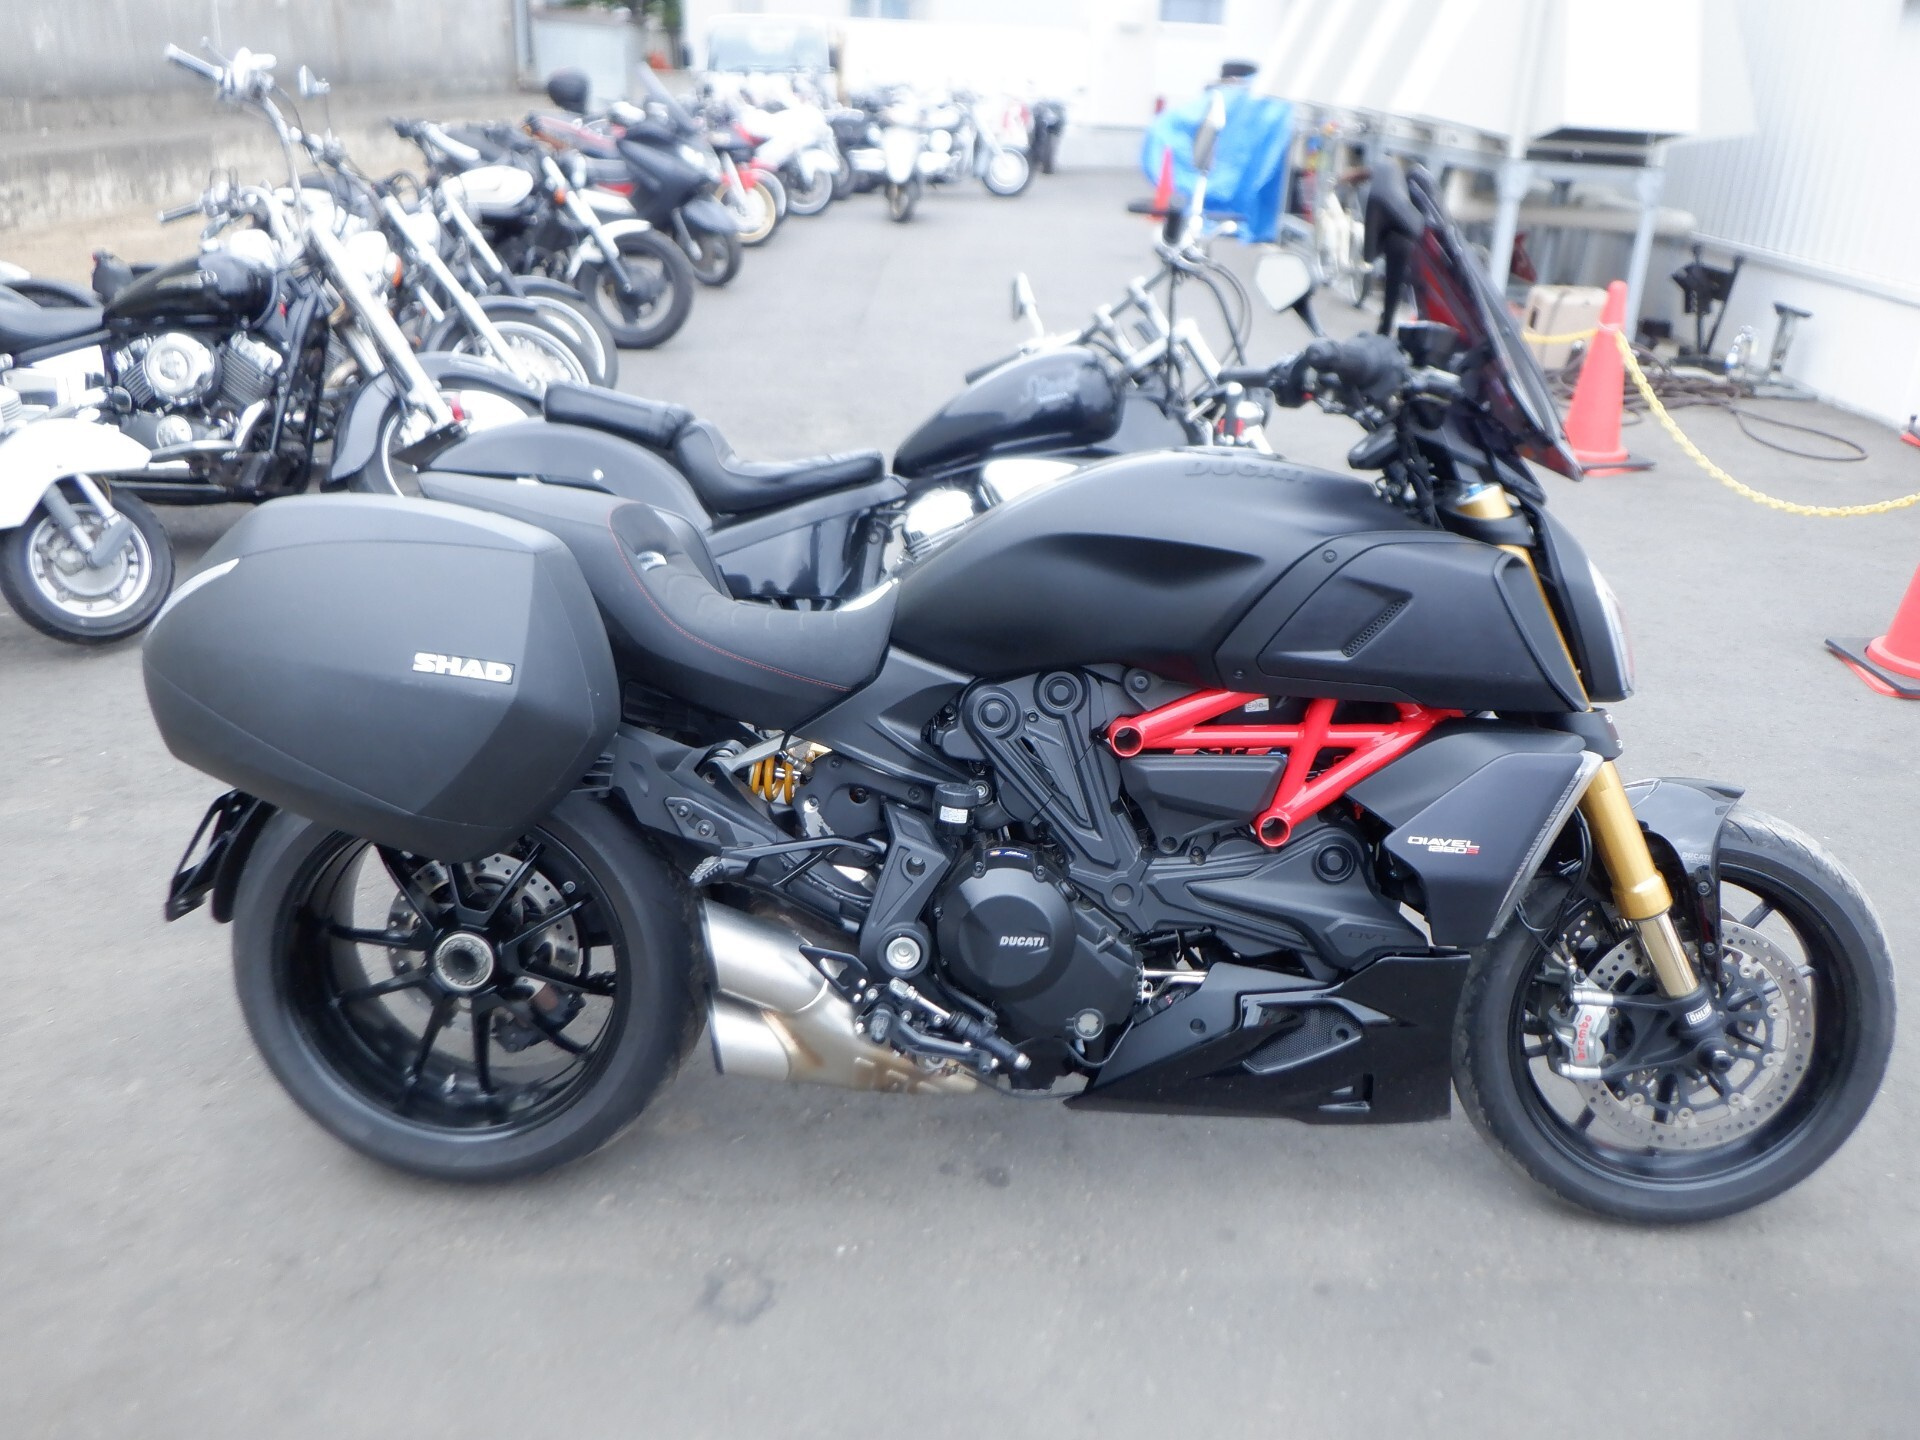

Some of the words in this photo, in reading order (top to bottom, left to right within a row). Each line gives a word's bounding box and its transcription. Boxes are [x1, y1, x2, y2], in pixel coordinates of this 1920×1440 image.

[412, 652, 513, 682] SHAD
[1407, 836, 1480, 849] DIAVEL
[999, 935, 1045, 947] DUCATI
[1575, 1014, 1593, 1061] brembo
